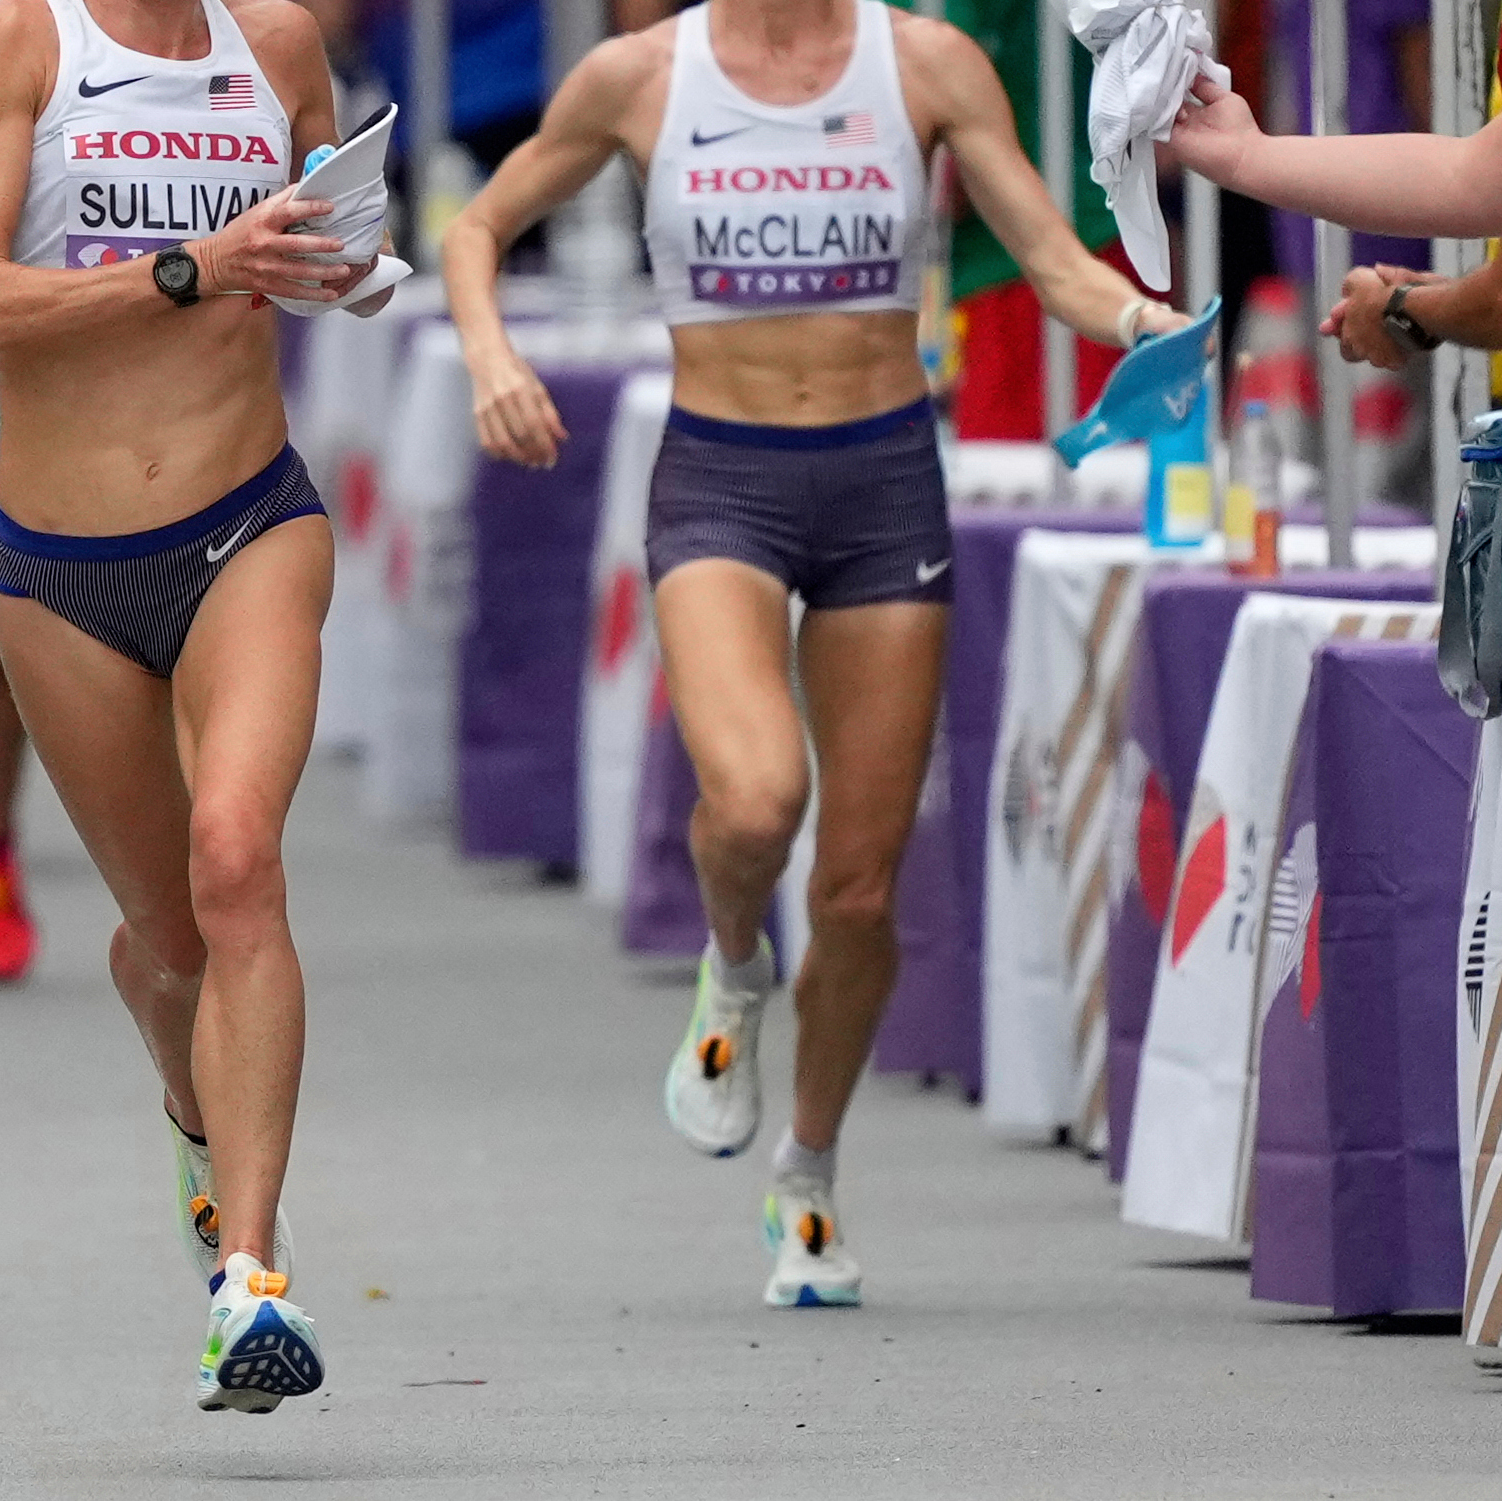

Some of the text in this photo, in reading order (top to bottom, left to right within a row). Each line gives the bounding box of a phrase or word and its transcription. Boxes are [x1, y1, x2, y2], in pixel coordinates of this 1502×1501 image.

[69, 130, 279, 165] HONDA
[686, 164, 895, 194] HONDA
[694, 214, 893, 258] McCLAIN
